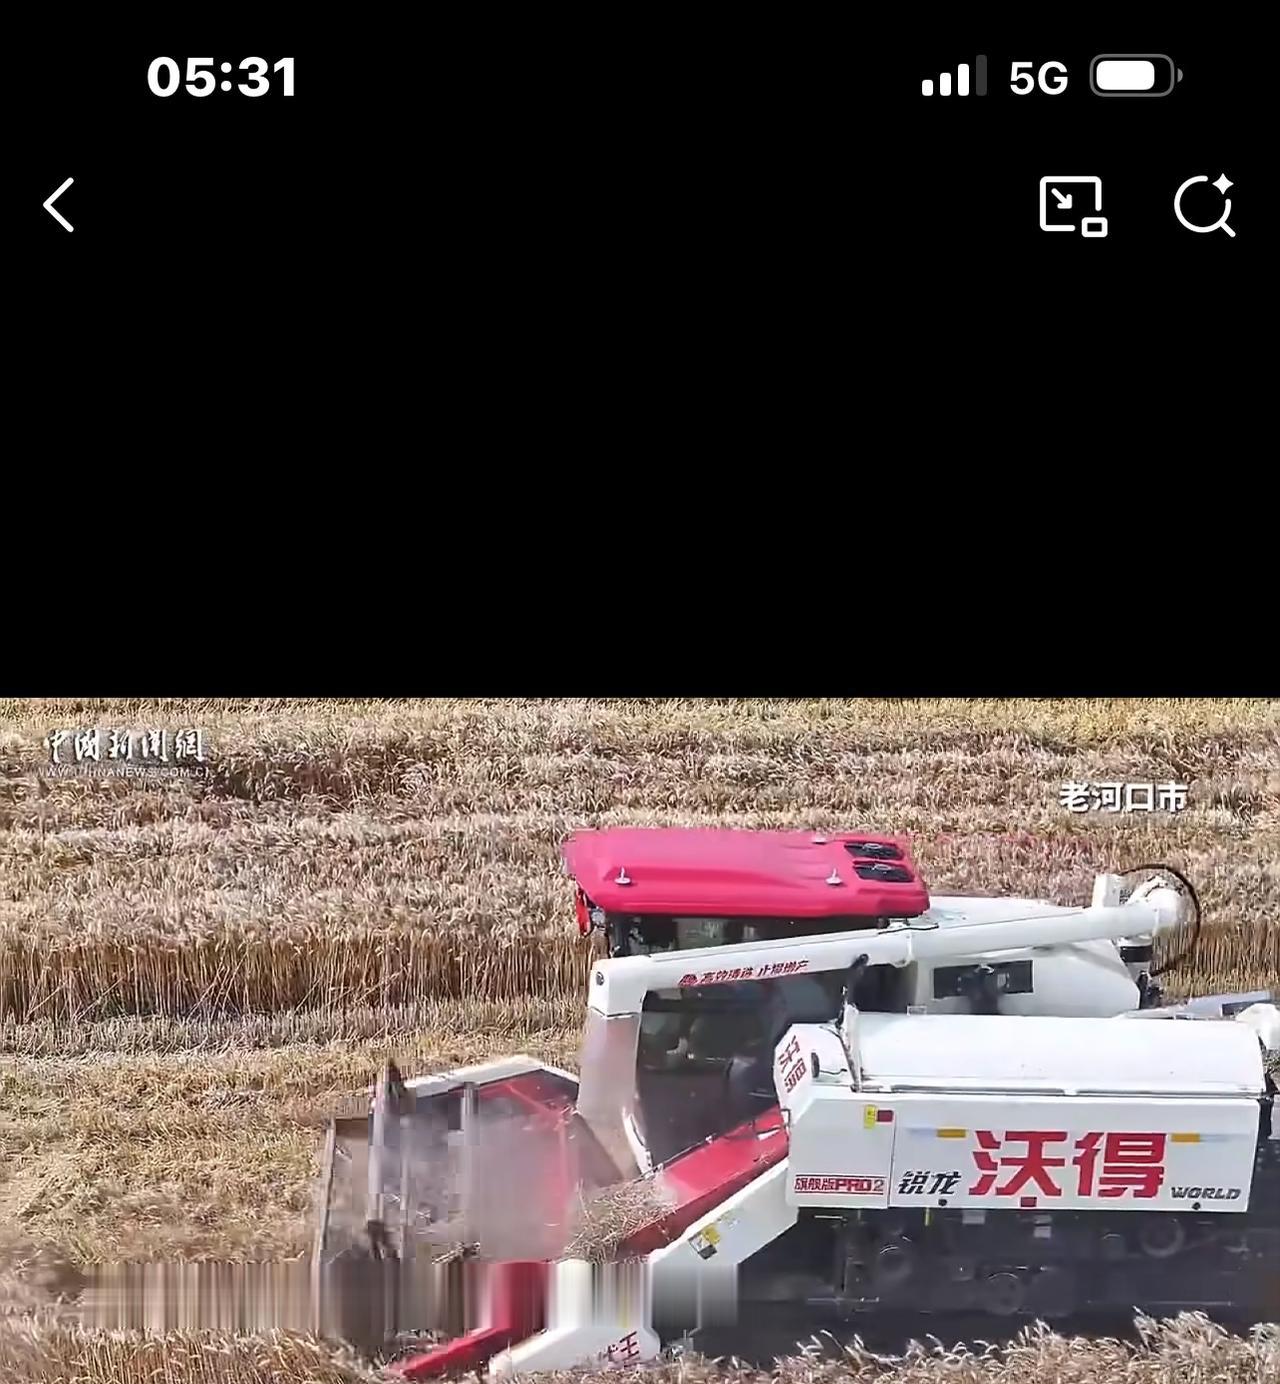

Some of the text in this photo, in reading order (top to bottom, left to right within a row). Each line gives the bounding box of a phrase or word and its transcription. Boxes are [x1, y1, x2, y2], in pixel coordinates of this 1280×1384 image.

[147, 57, 295, 98] 05:31
[1009, 60, 1069, 96] 5G
[898, 1170, 962, 1195] 锐龙
[969, 1131, 1167, 1198] 沃得
[1171, 1187, 1241, 1200] WORLD
